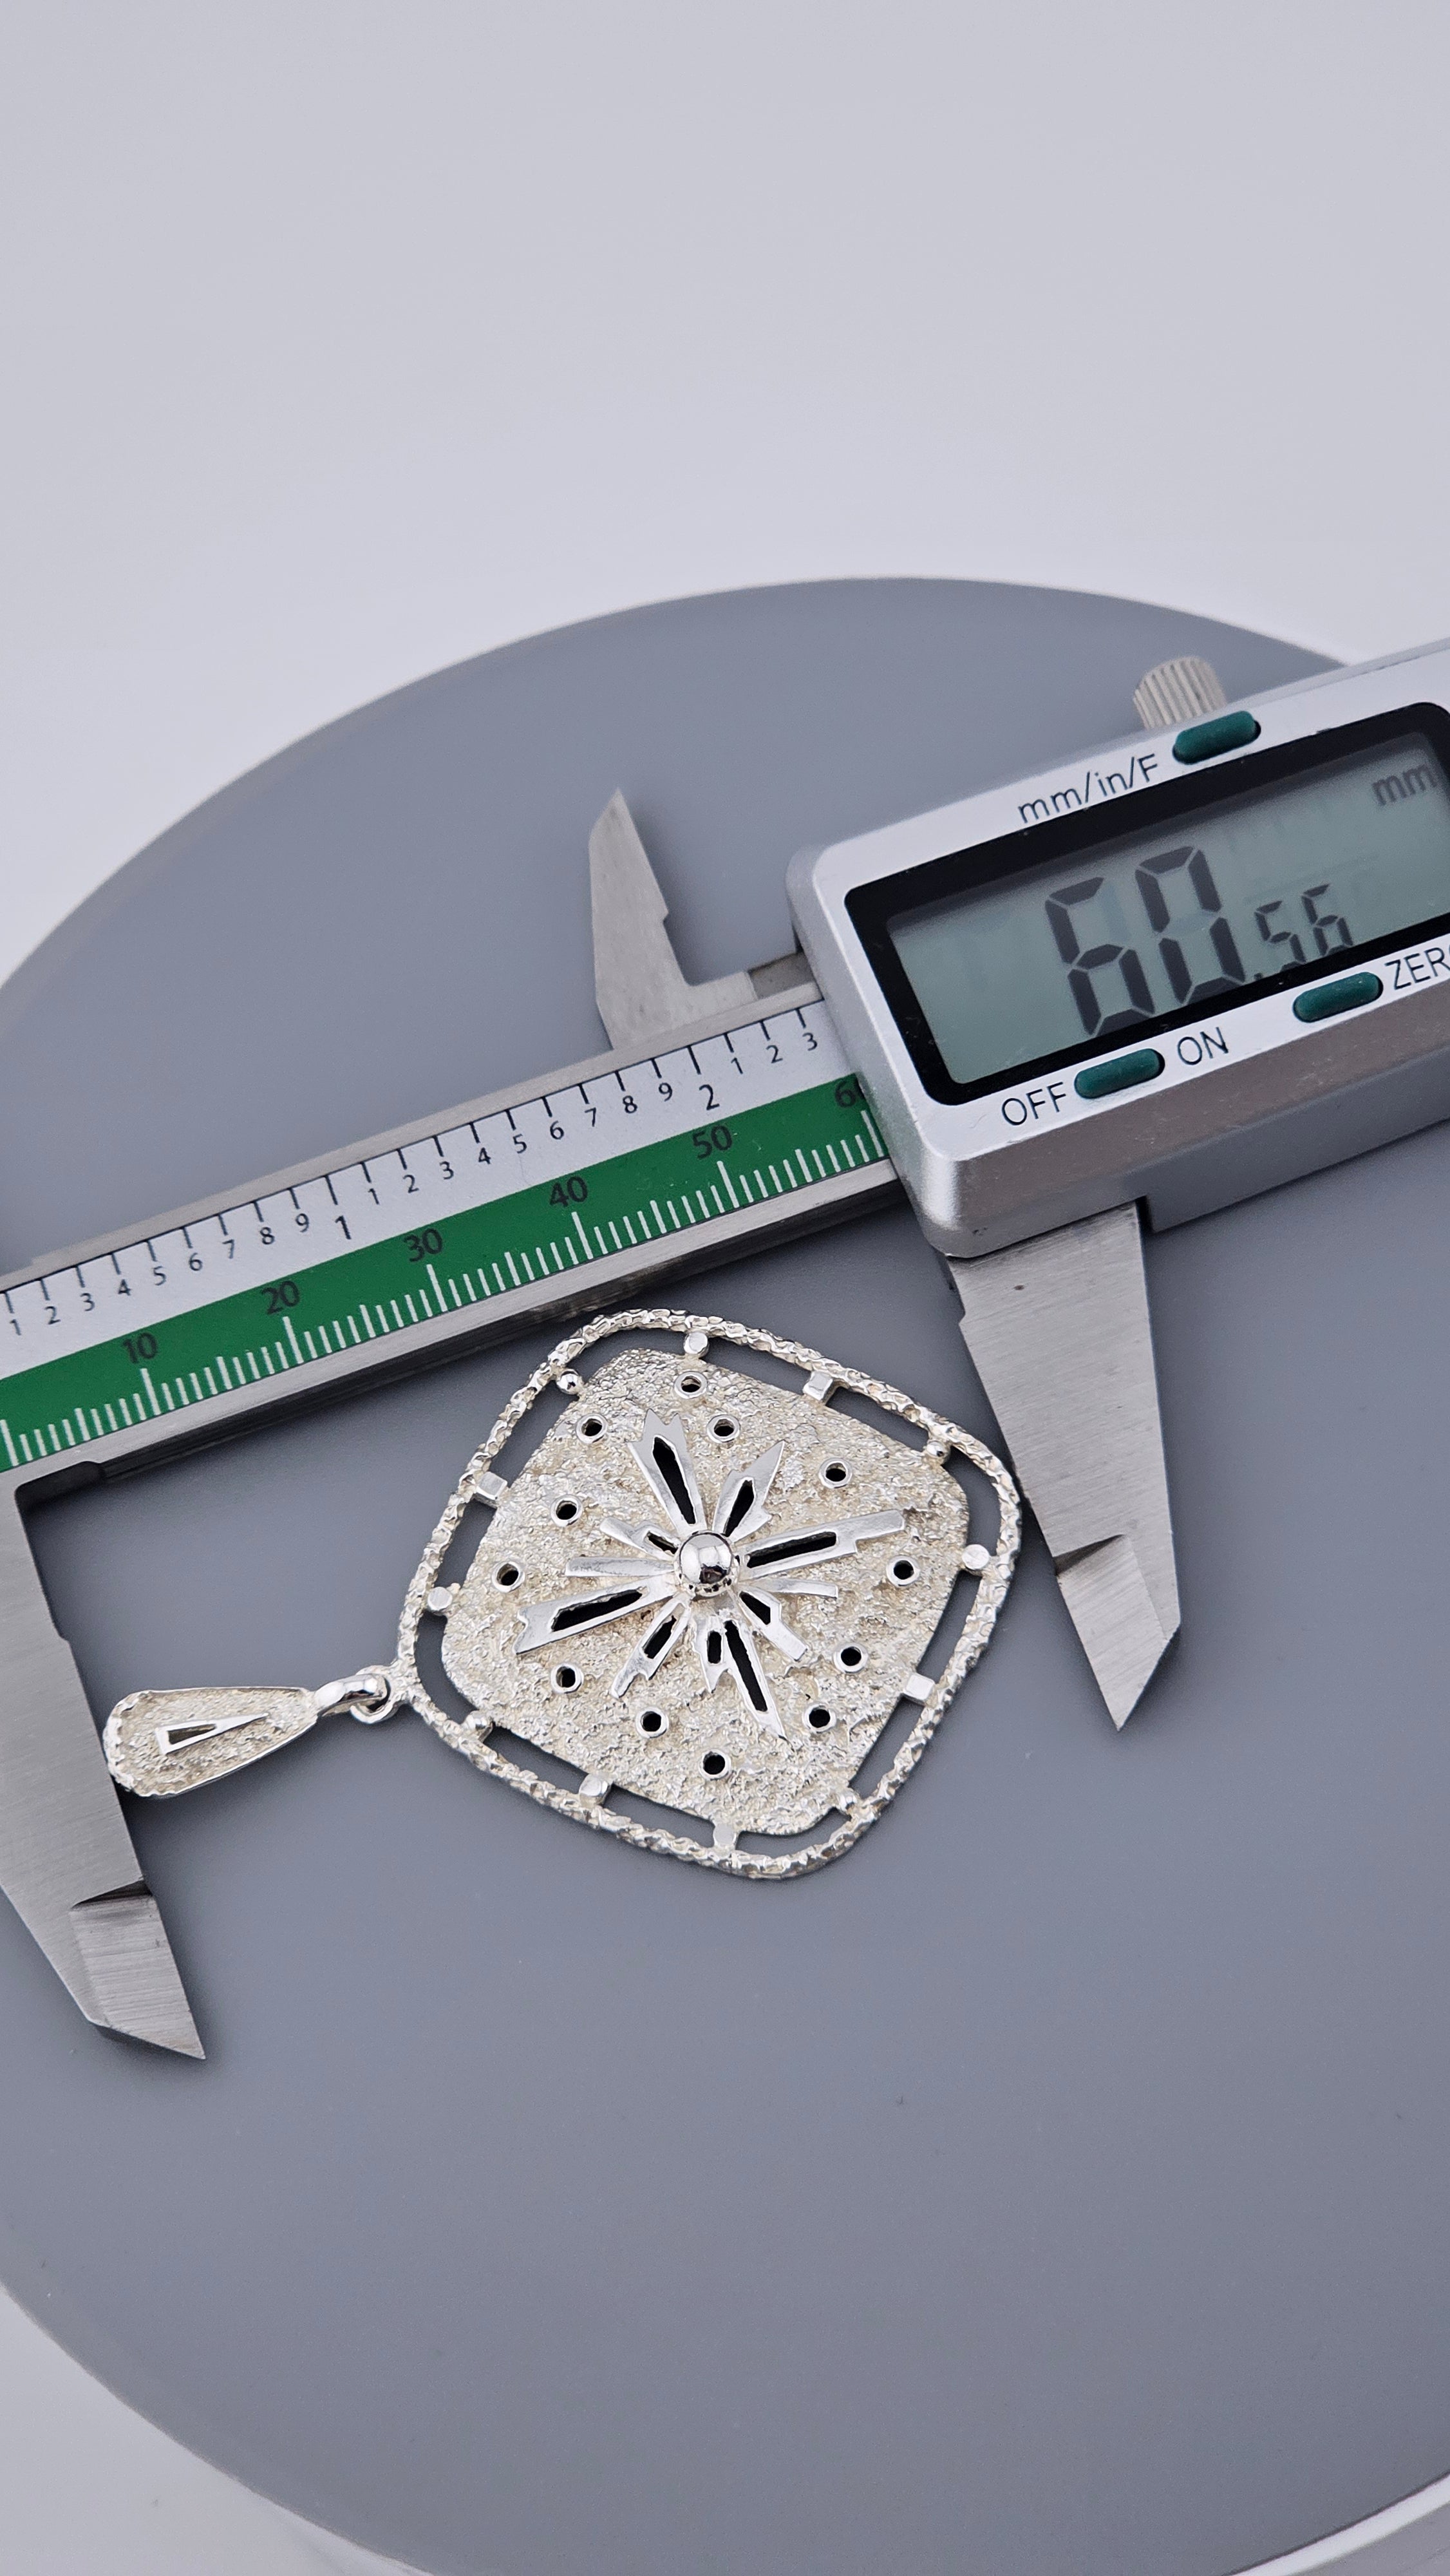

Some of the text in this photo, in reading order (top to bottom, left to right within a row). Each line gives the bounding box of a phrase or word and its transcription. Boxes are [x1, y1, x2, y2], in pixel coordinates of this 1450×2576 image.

[1018, 754, 1158, 824] mm/in/F
[1372, 764, 1436, 806] mm
[1384, 942, 1450, 990] ZER
[1176, 1027, 1230, 1066] ON
[1001, 1082, 1067, 1126] OFF
[10, 1032, 818, 1336] 1 2 3 4 5 6 7 8 9 1 1 2 3 4 5 6 7 8 9 2 1 2 3
[122, 1079, 865, 1364] 10 20 30 40 50 6
